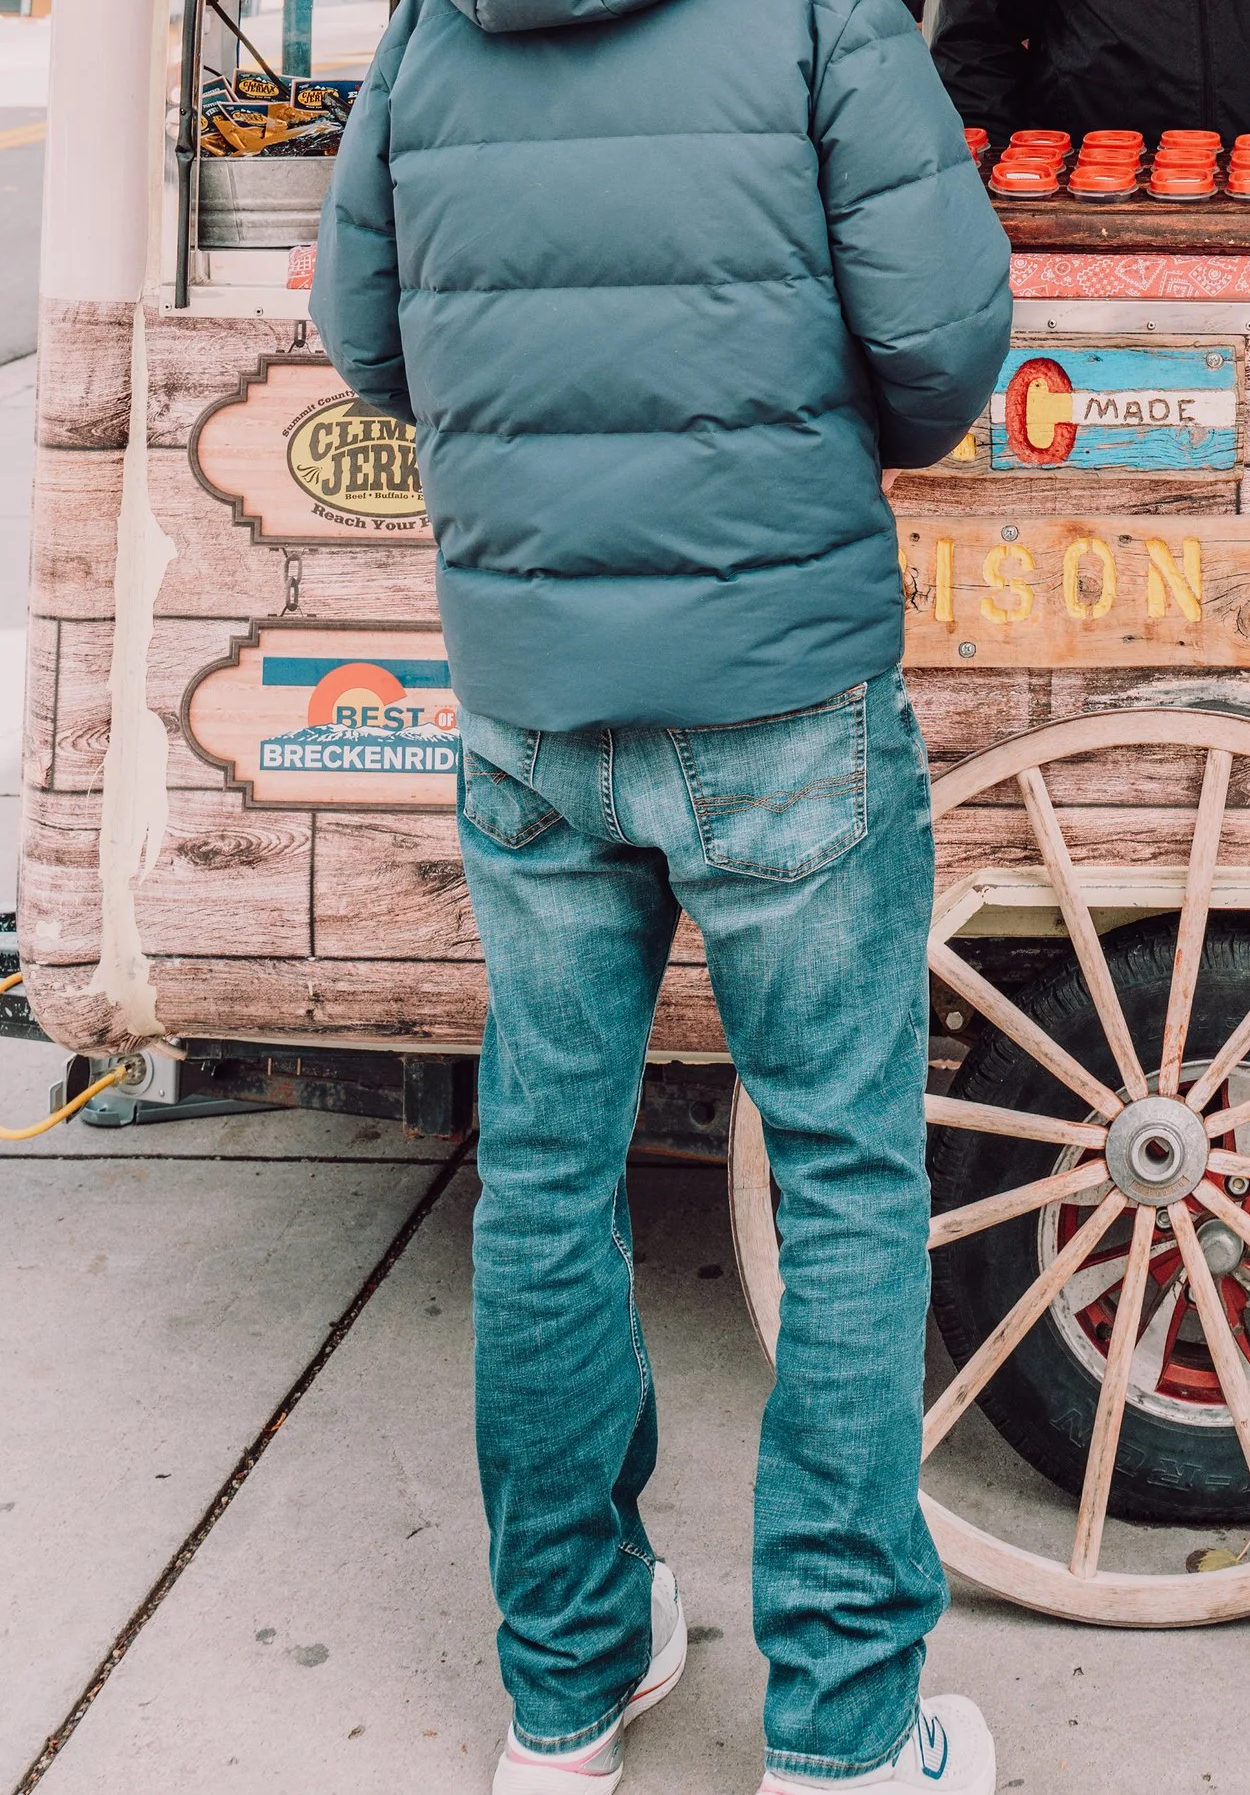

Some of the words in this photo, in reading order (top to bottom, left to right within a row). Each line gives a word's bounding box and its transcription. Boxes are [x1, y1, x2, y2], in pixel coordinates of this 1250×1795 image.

[282, 404, 316, 437] Summit
[317, 390, 356, 406] County
[1084, 397, 1197, 425] MADE
[309, 420, 416, 462] CLIM
[345, 492, 366, 500] Beef
[311, 503, 366, 529] Reach
[372, 519, 416, 531] Your
[898, 537, 1203, 623] ISON
[336, 706, 425, 731] BEST
[438, 712, 454, 727] OF
[263, 743, 458, 770] BRECKENRID
